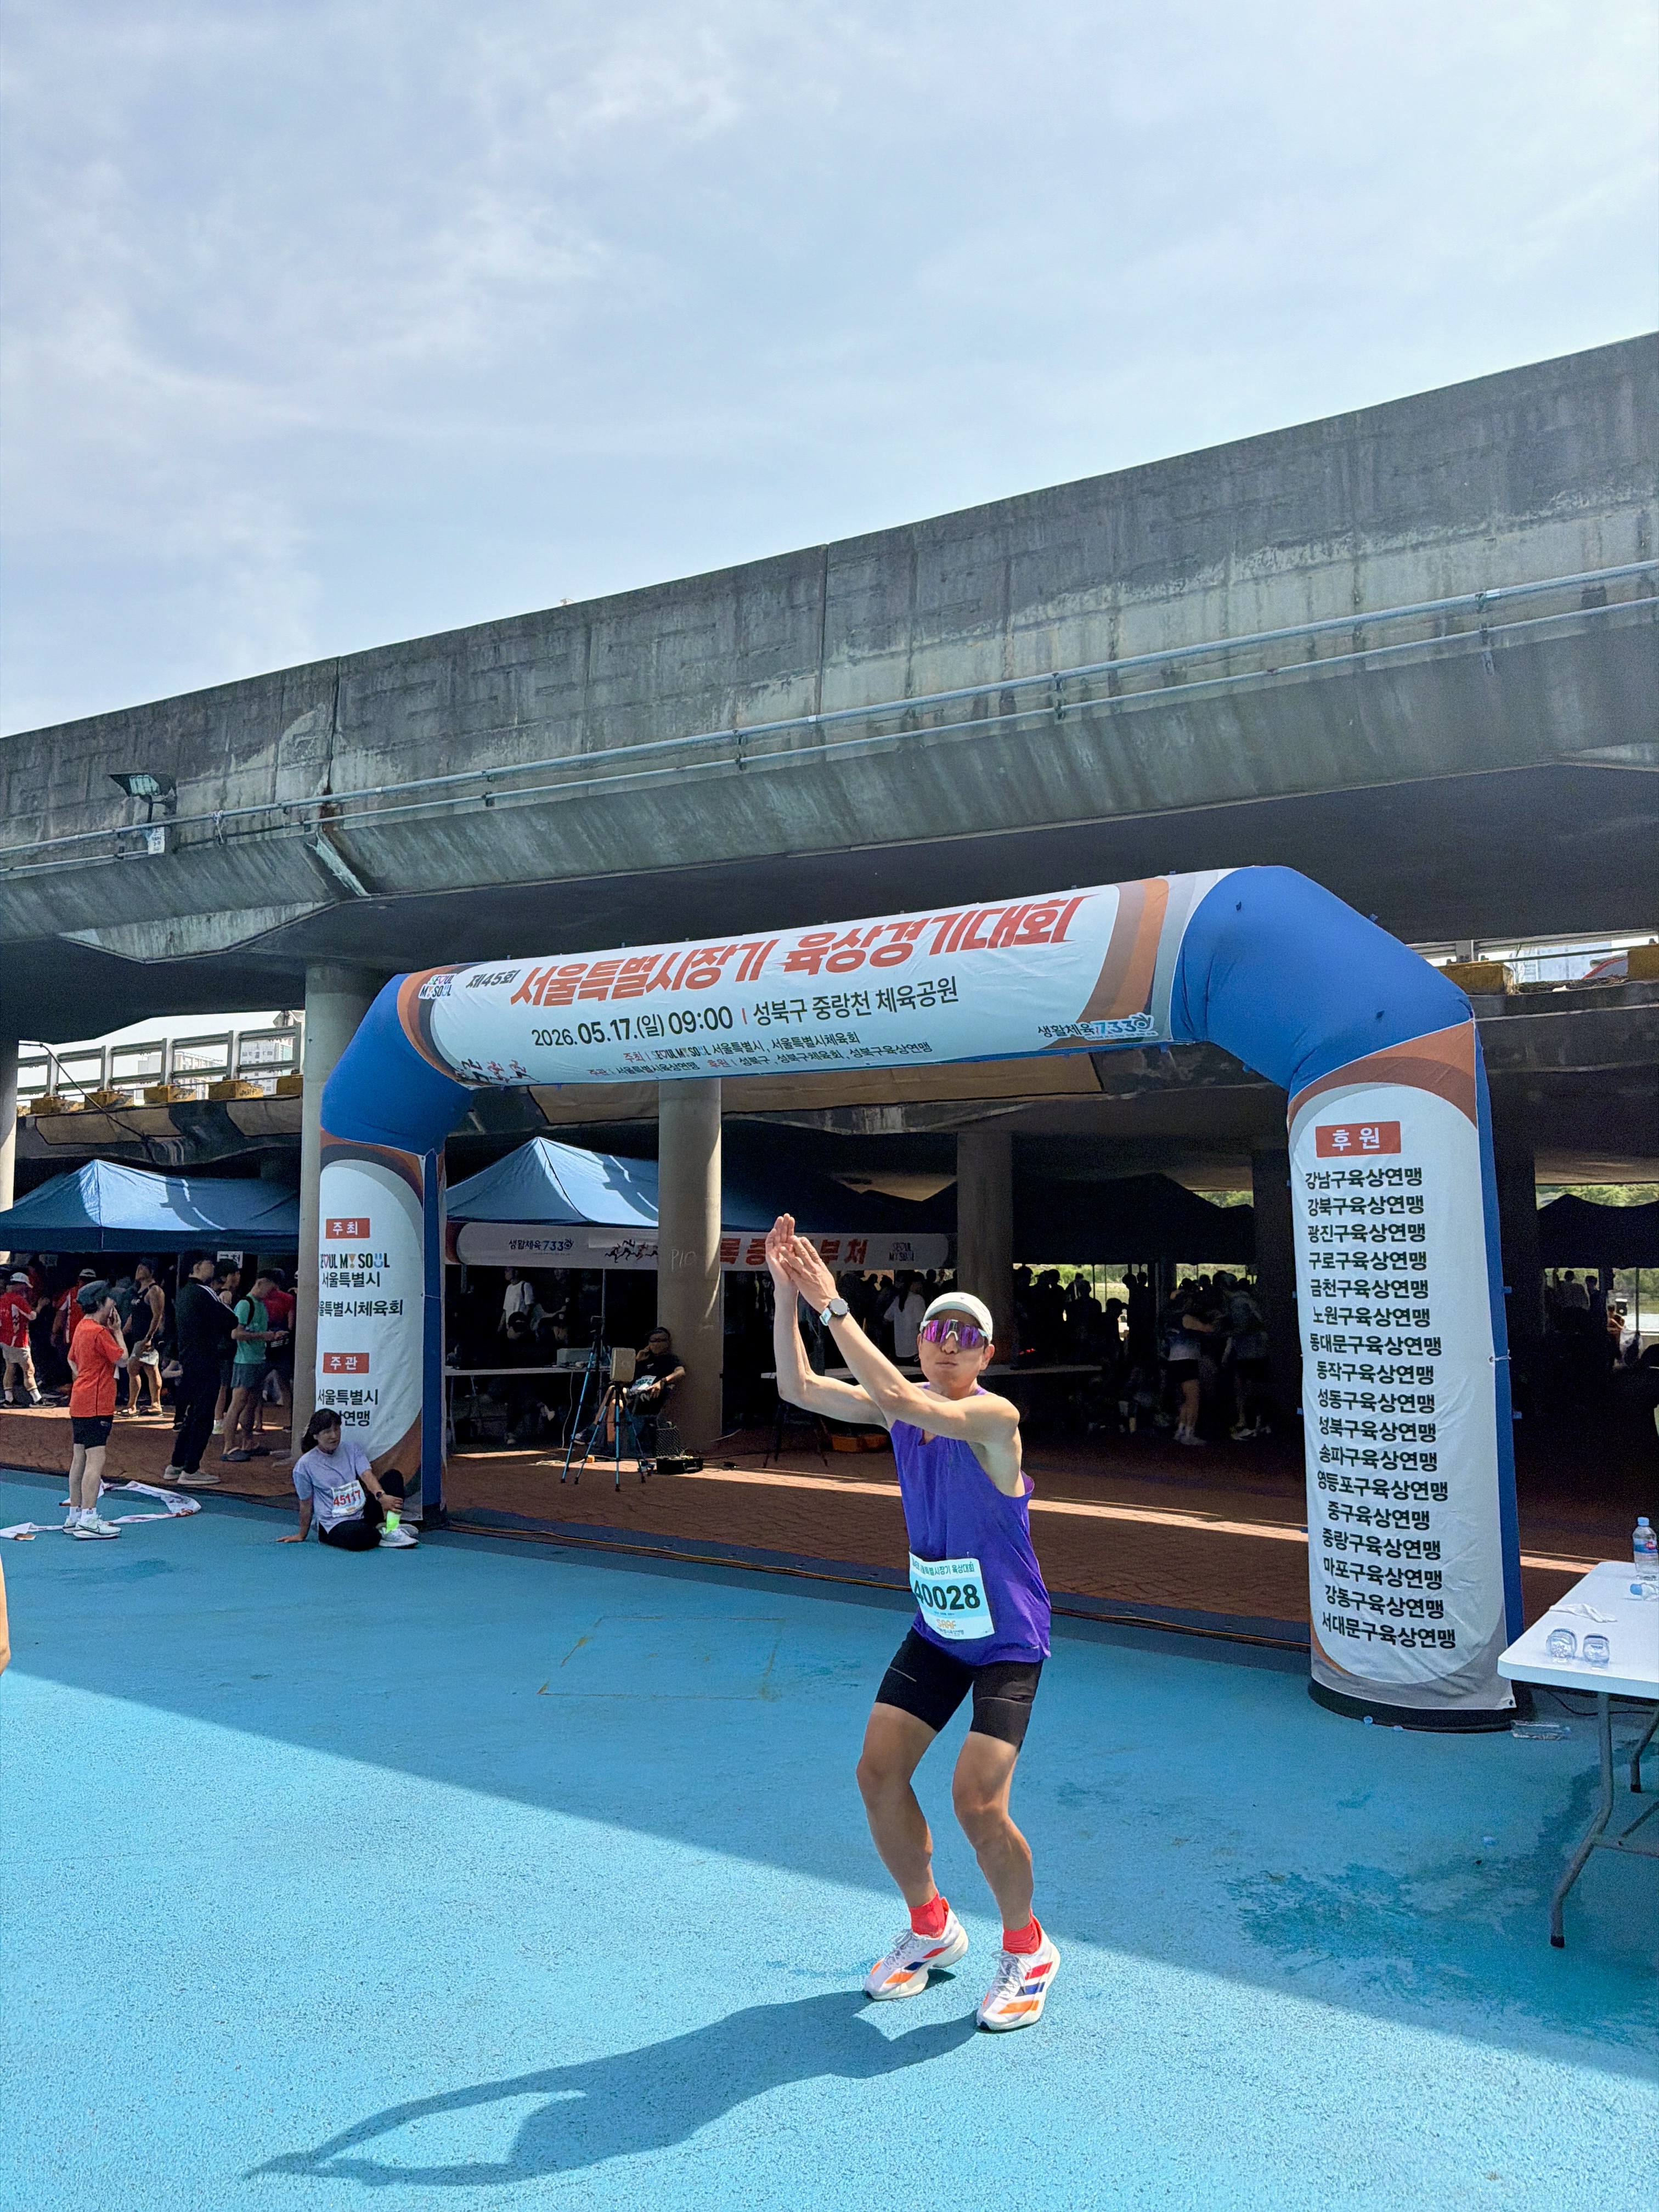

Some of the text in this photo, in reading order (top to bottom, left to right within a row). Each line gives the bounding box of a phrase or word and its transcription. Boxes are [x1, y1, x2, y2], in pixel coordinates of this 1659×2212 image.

[466, 893, 1098, 1007] 제45회 서울특별시장기 육상경기대회
[668, 1006, 733, 1035] 09:00
[753, 998, 808, 1025] 성북구
[812, 989, 872, 1020] 중랑천
[876, 976, 959, 1013] 체육공원
[623, 1051, 646, 1063] 주최
[772, 1031, 861, 1051] 서울특별시체육회
[850, 1042, 933, 1058] 성북구육상연맹
[1332, 1127, 1380, 1151] 후원
[1305, 1167, 1422, 1189] 강남구육상연맹
[1308, 1195, 1424, 1216] 강북구육상연맹
[332, 1221, 358, 1235] 주최
[1308, 1223, 1425, 1243] 광진구육상연맹
[1309, 1251, 1427, 1271] 구로구육상연맹
[321, 1271, 380, 1288] 서울특별시
[1311, 1279, 1428, 1299] 금천구육상연맹
[319, 1299, 403, 1317] 울특별시체육회
[1313, 1306, 1430, 1327] 노원구육상연맹
[1310, 1333, 1442, 1357] 동대문구육상연맹
[330, 1356, 358, 1370] 주관
[1317, 1361, 1434, 1385] 동작구육상연맹
[317, 1389, 379, 1406] 서울특별시
[1318, 1388, 1435, 1414] 성동구육상연맹
[339, 1410, 370, 1427] 연맹
[1319, 1416, 1436, 1443] 성북구육상연맹
[1319, 1443, 1437, 1472] 송파구육상연맹
[1317, 1470, 1448, 1502] 영등포구육상연맹
[1328, 1500, 1430, 1531] 중구육상연맹
[1322, 1527, 1441, 1560] 중랑구육상연맹
[1323, 1557, 1442, 1590] 마포구육상연맹
[914, 1579, 980, 1610] 40028
[1324, 1584, 1444, 1620] 강동구육상연맹
[1322, 1611, 1456, 1649] 서대문구육상연맹
